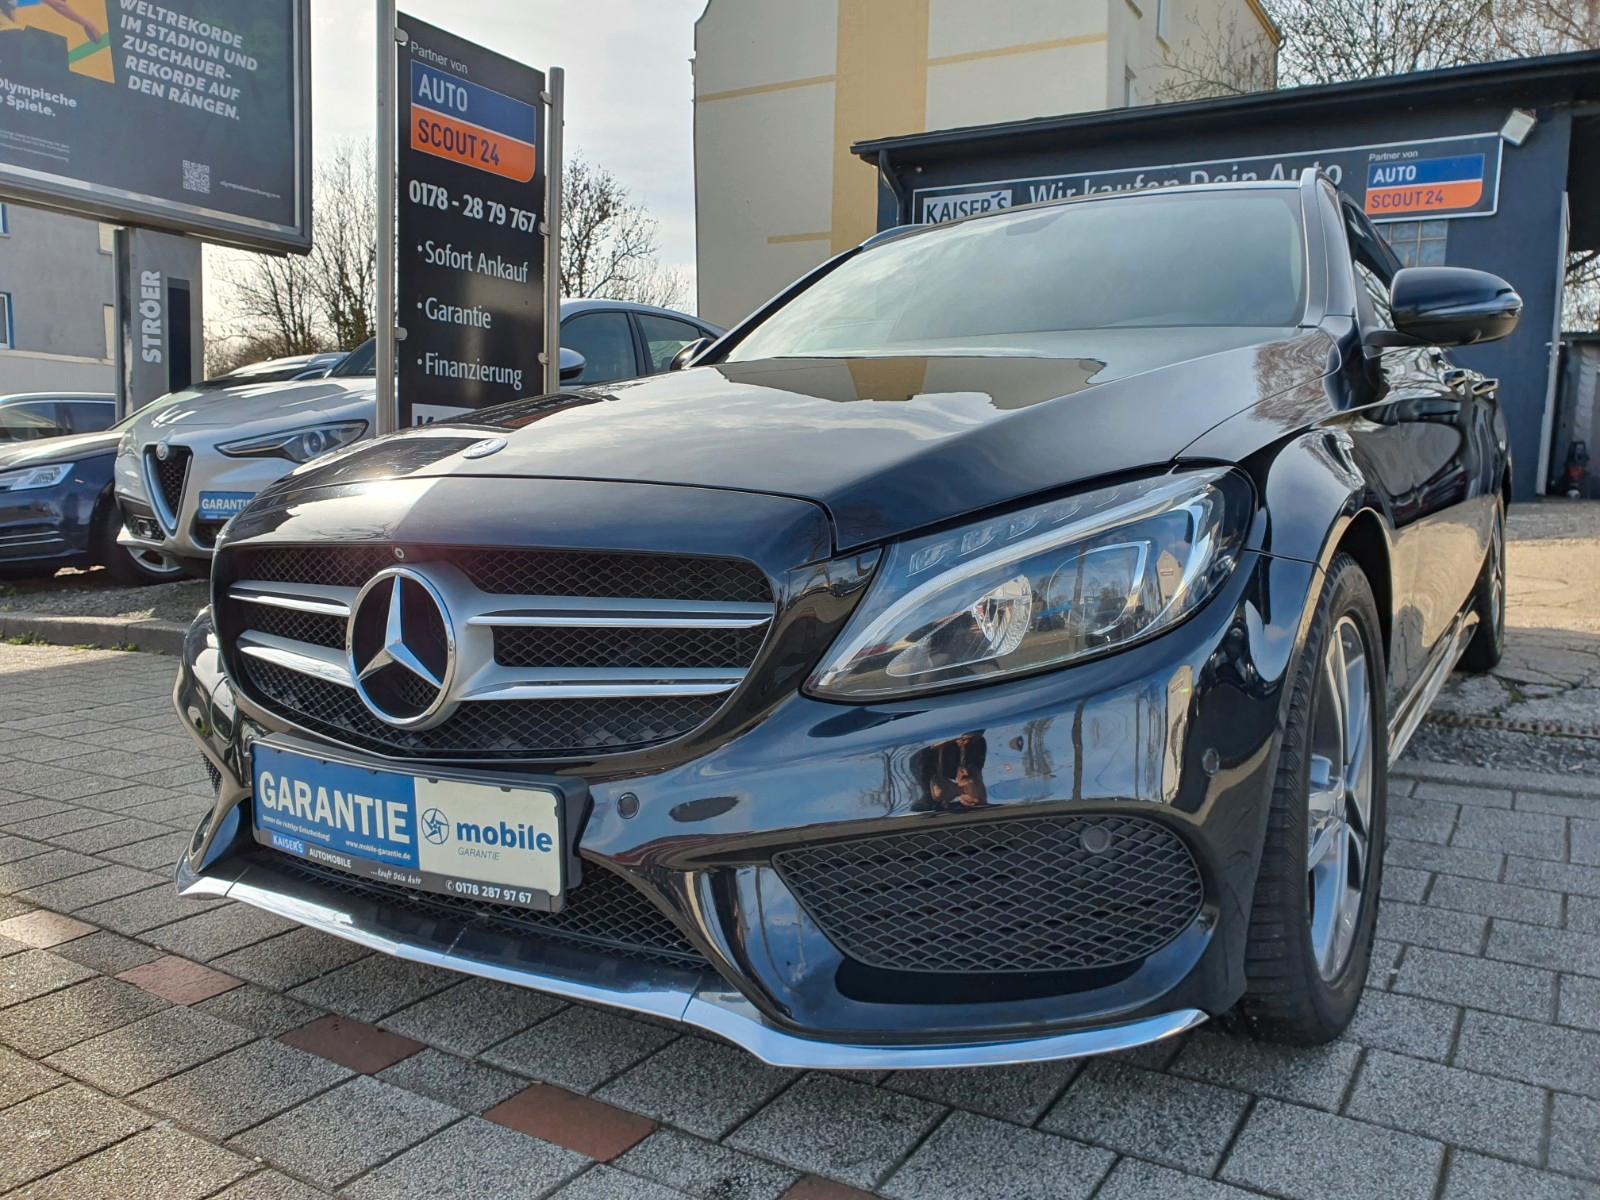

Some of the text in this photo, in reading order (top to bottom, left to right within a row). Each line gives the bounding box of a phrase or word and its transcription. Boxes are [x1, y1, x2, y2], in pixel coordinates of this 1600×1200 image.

[120, 0, 243, 49] WELTREKORDE
[120, 14, 258, 71] IM STADION UND
[122, 35, 232, 79] ZUSCHAUER-
[125, 54, 241, 101] REKORDE AUF
[410, 41, 468, 74] Partner von
[6, 94, 56, 117] Spiele.
[128, 75, 240, 121] DEN RÄNGEN.
[418, 73, 468, 112] AUTO
[1369, 150, 1419, 161] Partner von
[1372, 165, 1417, 184] AUTO
[409, 179, 448, 210] 0178
[462, 194, 484, 220] 28
[487, 200, 507, 225] 79
[509, 207, 537, 233] 767
[476, 252, 528, 283] Ankauf
[139, 270, 162, 363] STRÖER
[259, 771, 410, 844] GARANTIE
[456, 821, 553, 852] mobile
[457, 847, 501, 861] GARANTIE
[309, 848, 352, 868] AUTOMOBILE
[455, 882, 480, 896] 0178
[481, 886, 501, 899] 287
[503, 890, 517, 902] 97
[518, 892, 532, 904] 67
